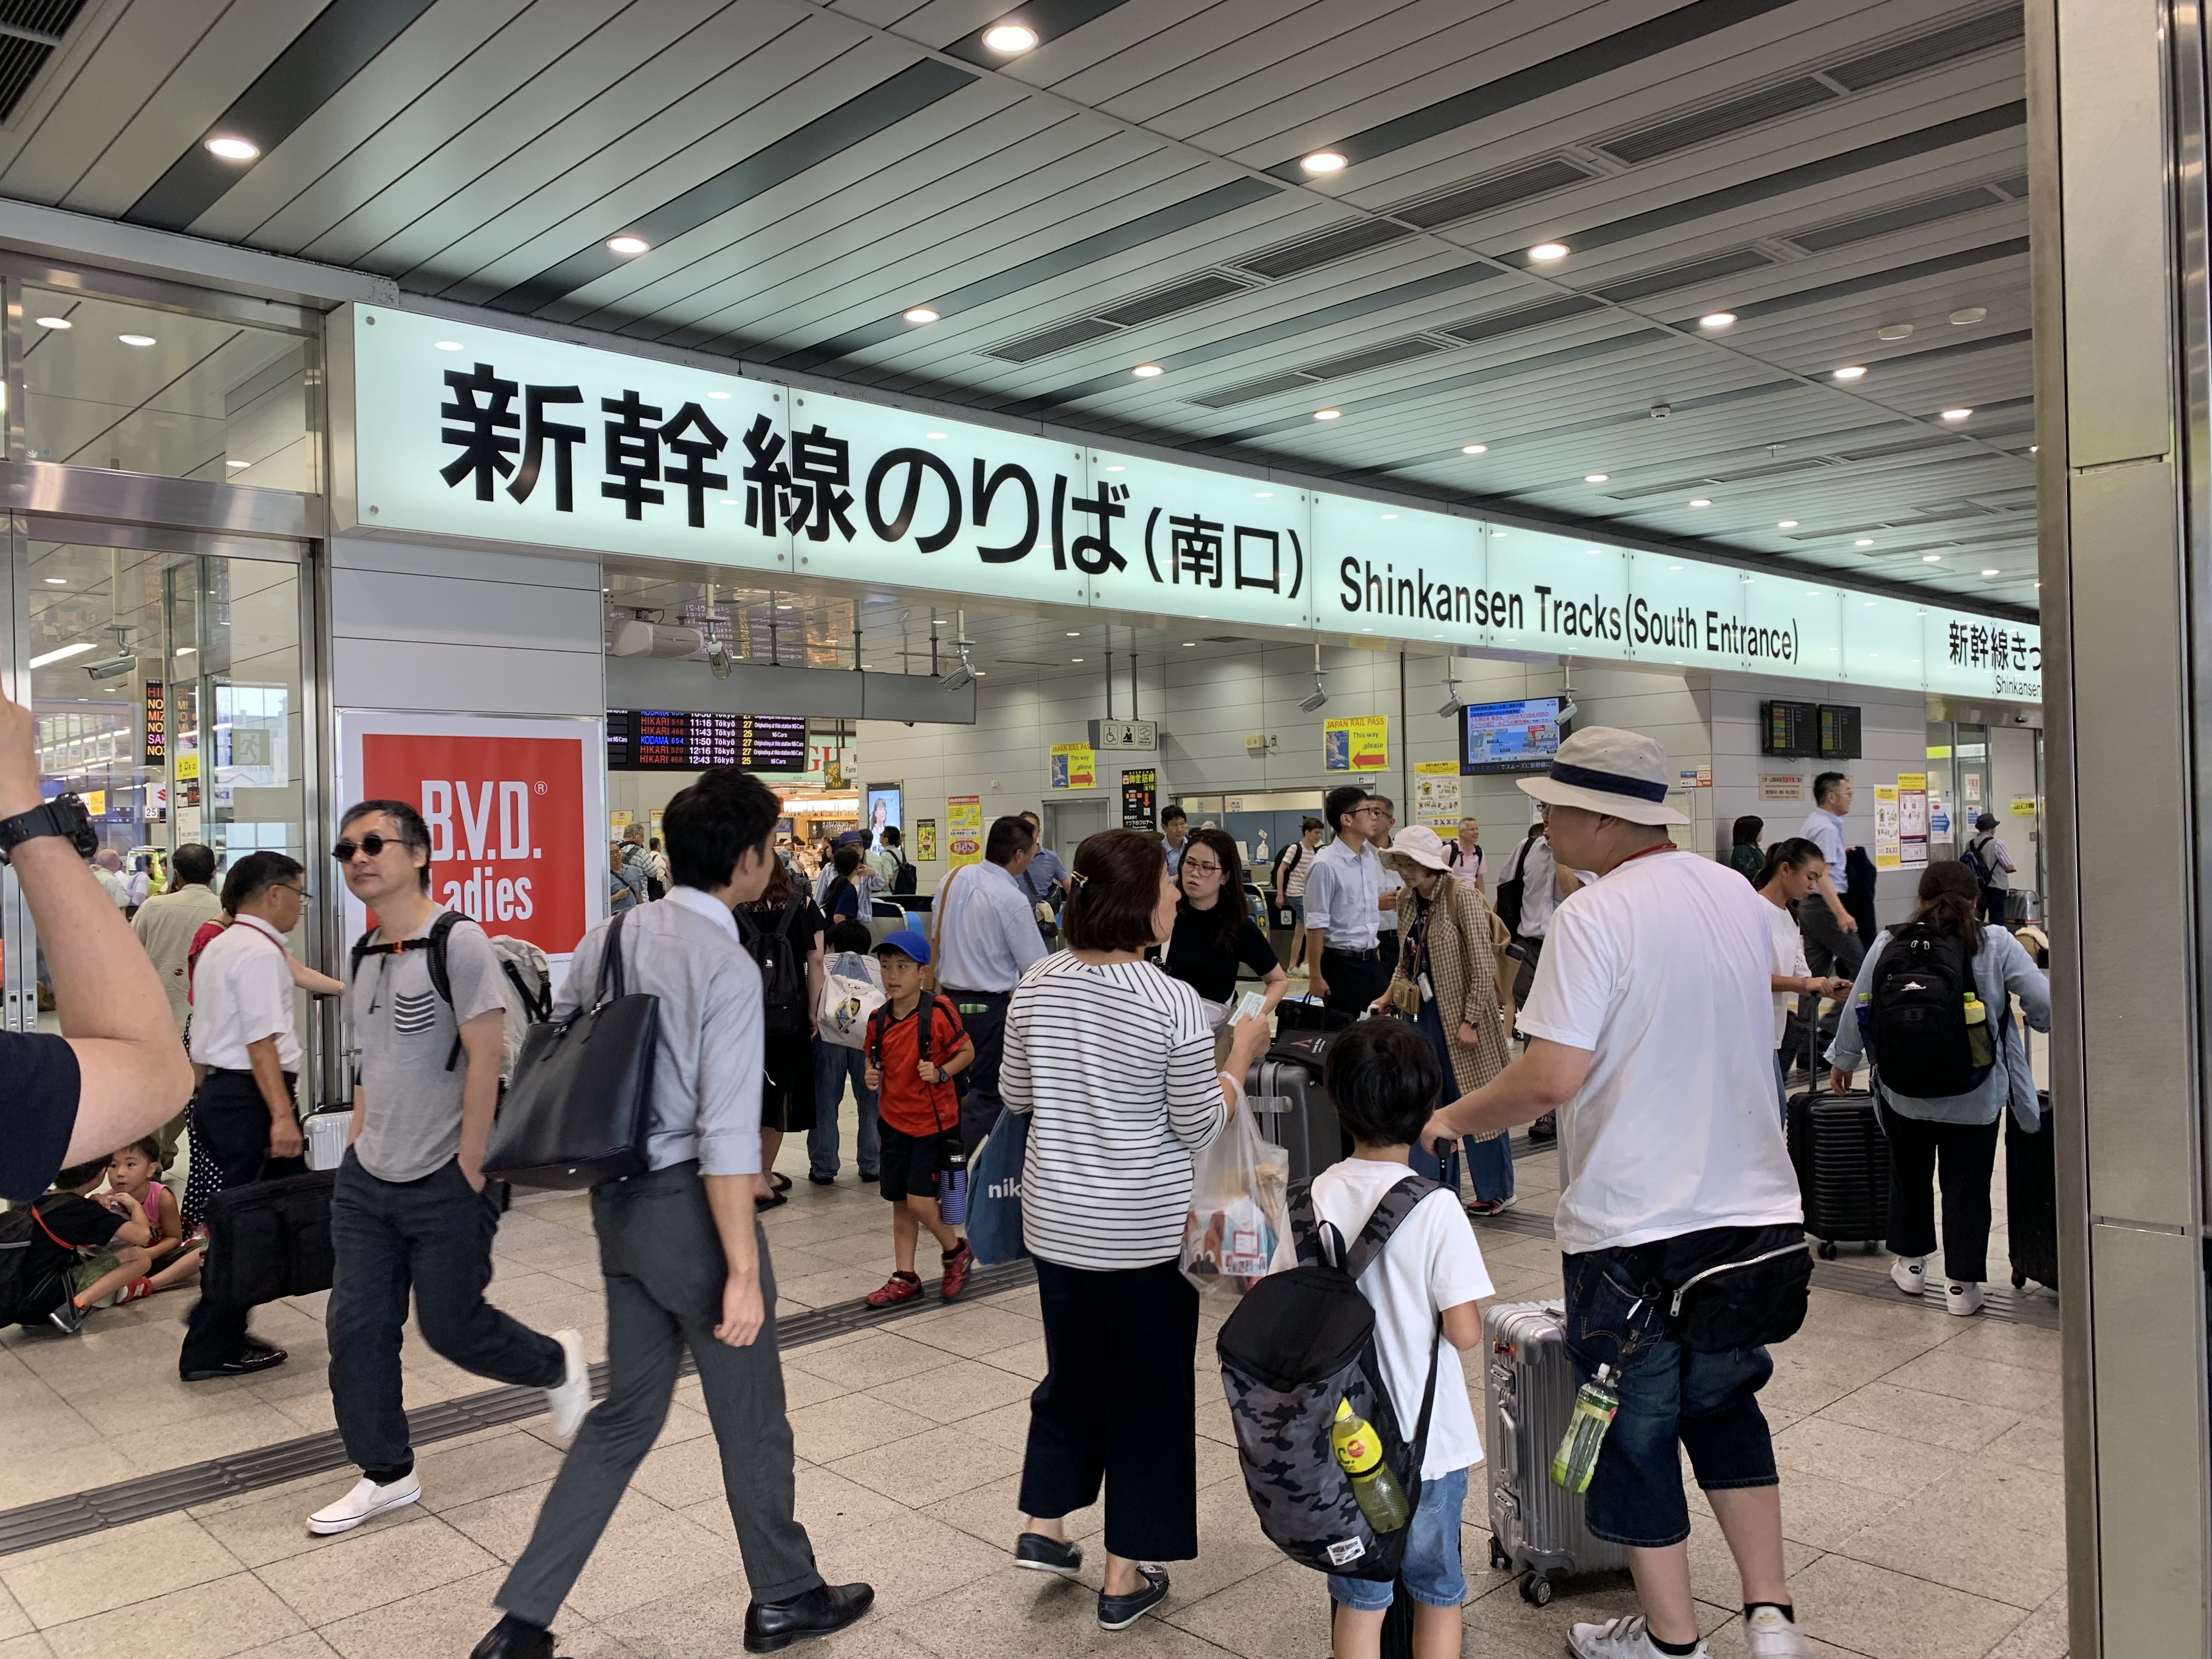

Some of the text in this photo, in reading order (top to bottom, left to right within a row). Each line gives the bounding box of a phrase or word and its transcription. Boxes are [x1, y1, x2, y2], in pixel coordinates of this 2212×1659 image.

[1341, 557, 1522, 629] Shinkansen
[1707, 611, 1797, 664] Entrance)
[1996, 675, 2041, 697] Shinkansen
[641, 717, 669, 725] HIKARI
[1327, 720, 1348, 729] JAPAN
[641, 726, 669, 735] HIKARI
[641, 736, 669, 744] KODAMA
[640, 746, 668, 754] HIKARI
[640, 755, 668, 764] HIKARI
[146, 809, 157, 817] 25
